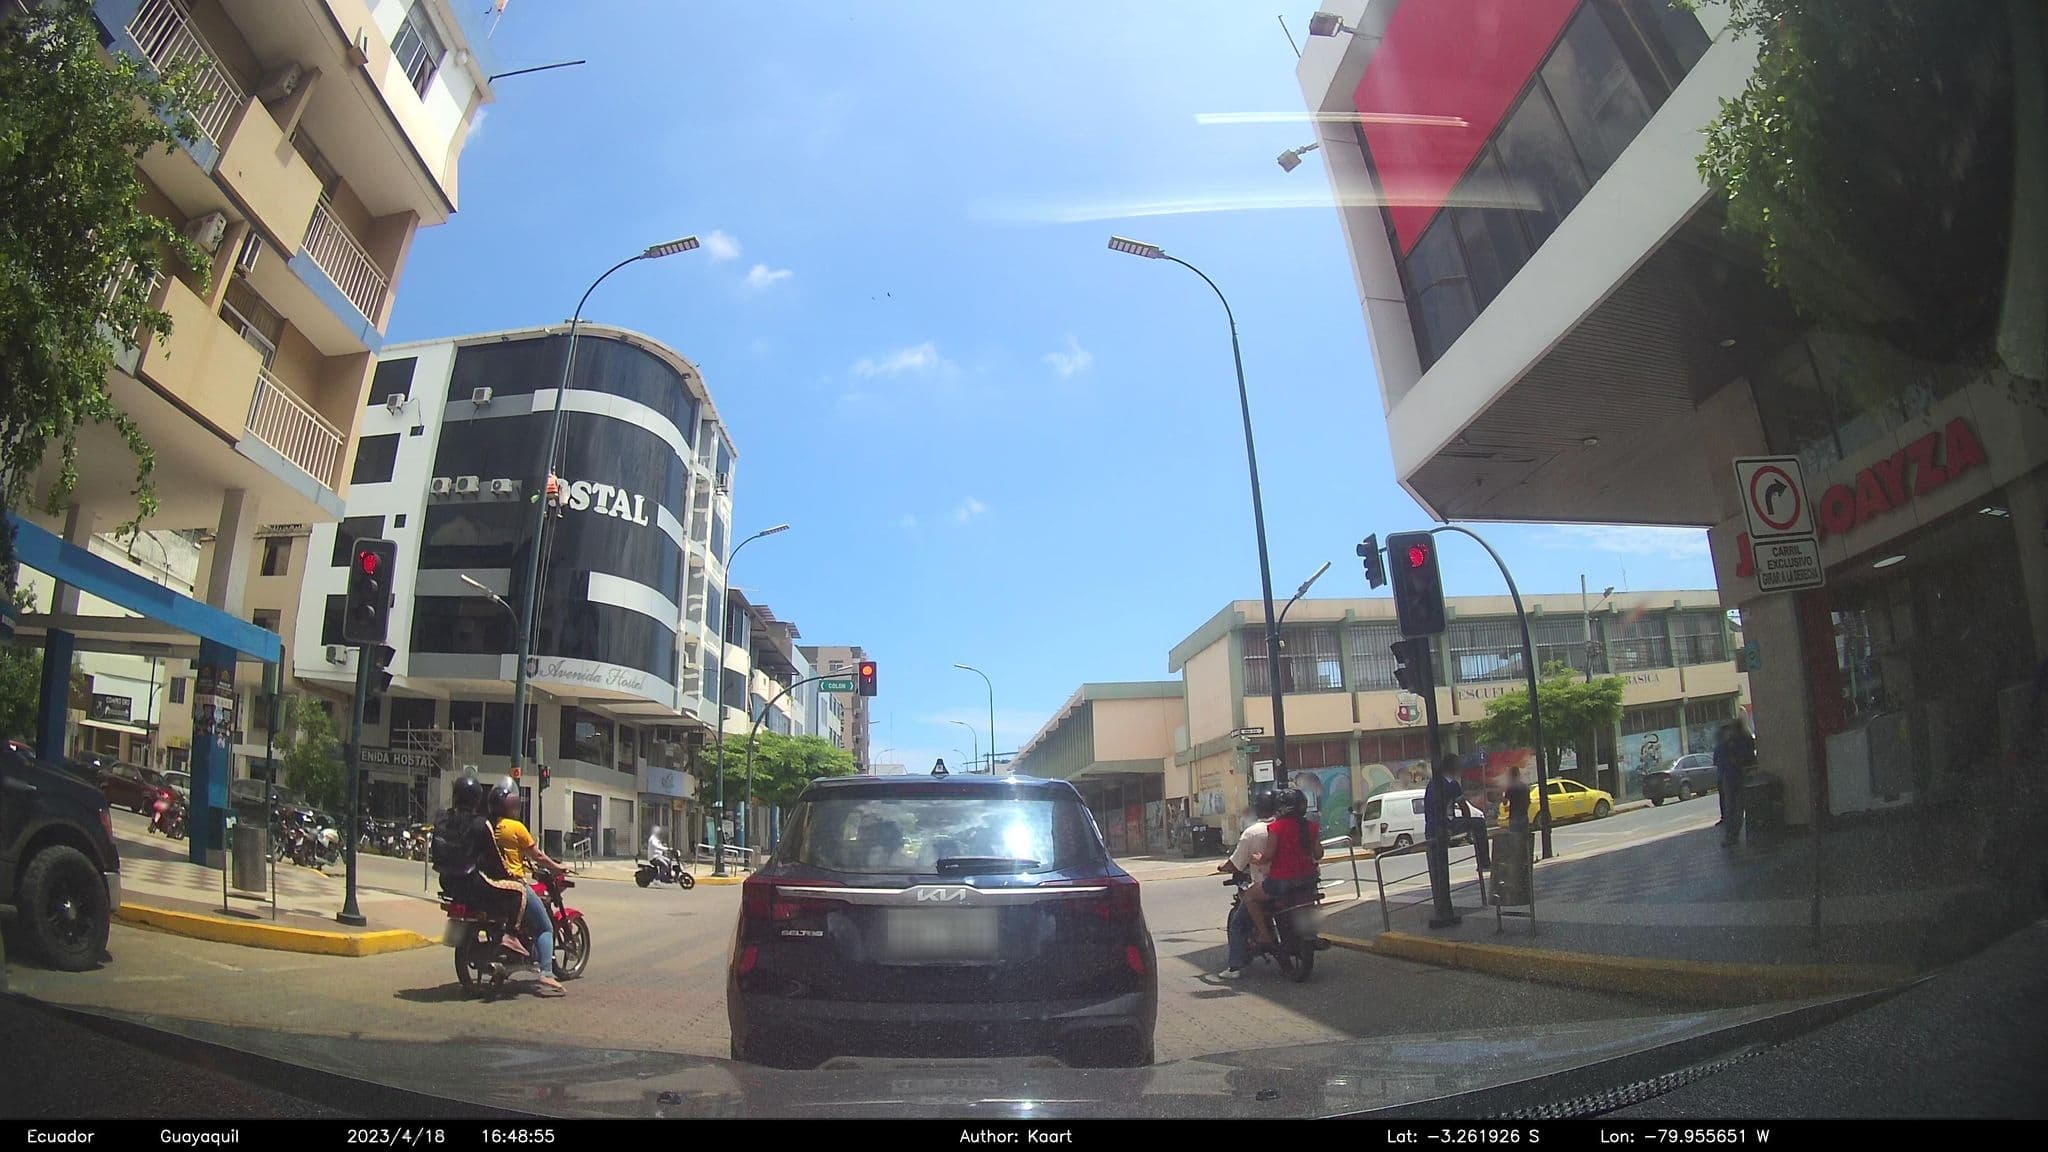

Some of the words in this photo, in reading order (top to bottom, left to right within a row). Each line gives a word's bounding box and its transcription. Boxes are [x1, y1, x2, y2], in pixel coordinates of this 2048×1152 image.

[1818, 417, 1987, 537] OAYZA
[556, 479, 649, 527] OSTAL
[1772, 544, 1802, 557] CARRIL
[1767, 556, 1813, 570] EXCLUSIVO
[1762, 571, 1780, 585] GIRAR
[540, 660, 602, 682] Avenida
[361, 750, 389, 764] ENIDA
[393, 753, 434, 767] HOSTAL
[917, 888, 966, 901] KIA
